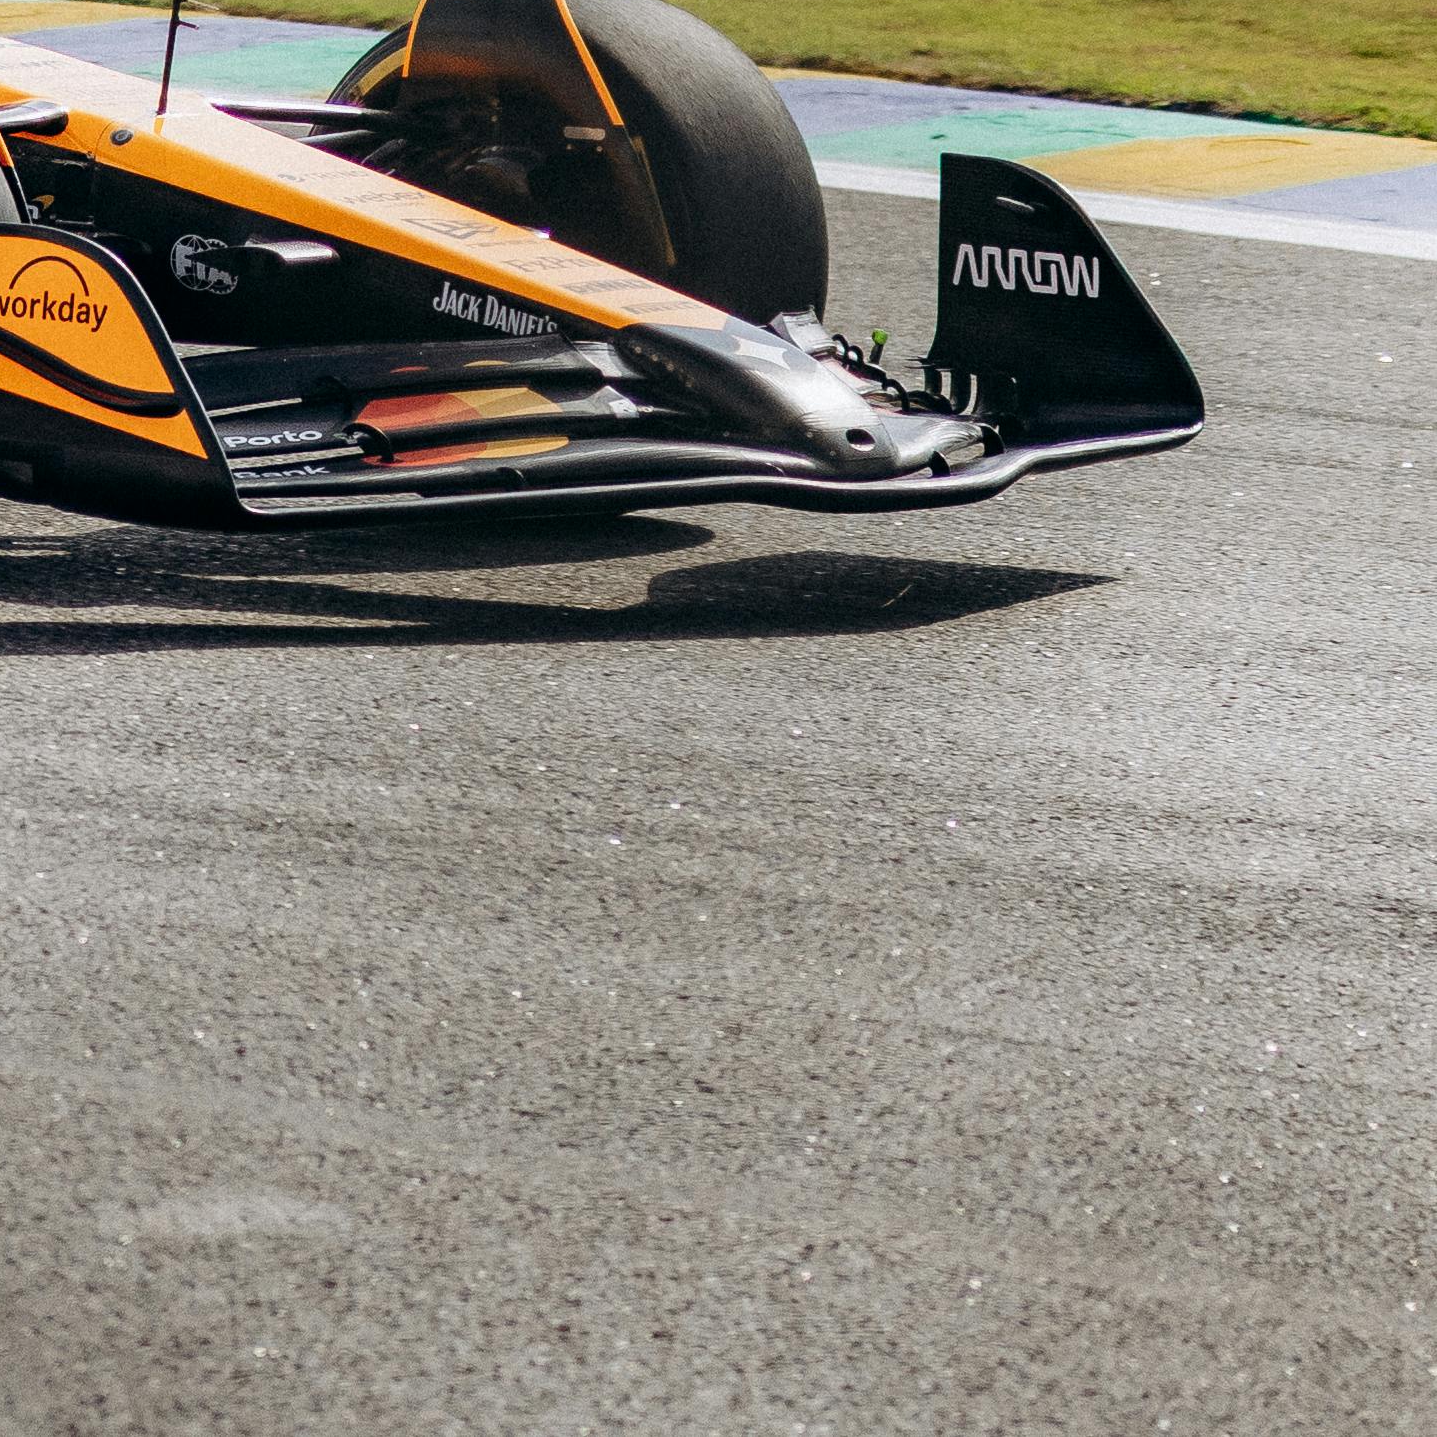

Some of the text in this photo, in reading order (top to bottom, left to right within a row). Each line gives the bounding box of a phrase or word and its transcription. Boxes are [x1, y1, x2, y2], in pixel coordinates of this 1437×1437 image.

[952, 244, 1100, 298] ARROW
[432, 281, 483, 323] JACK
[222, 430, 323, 448] Porto
